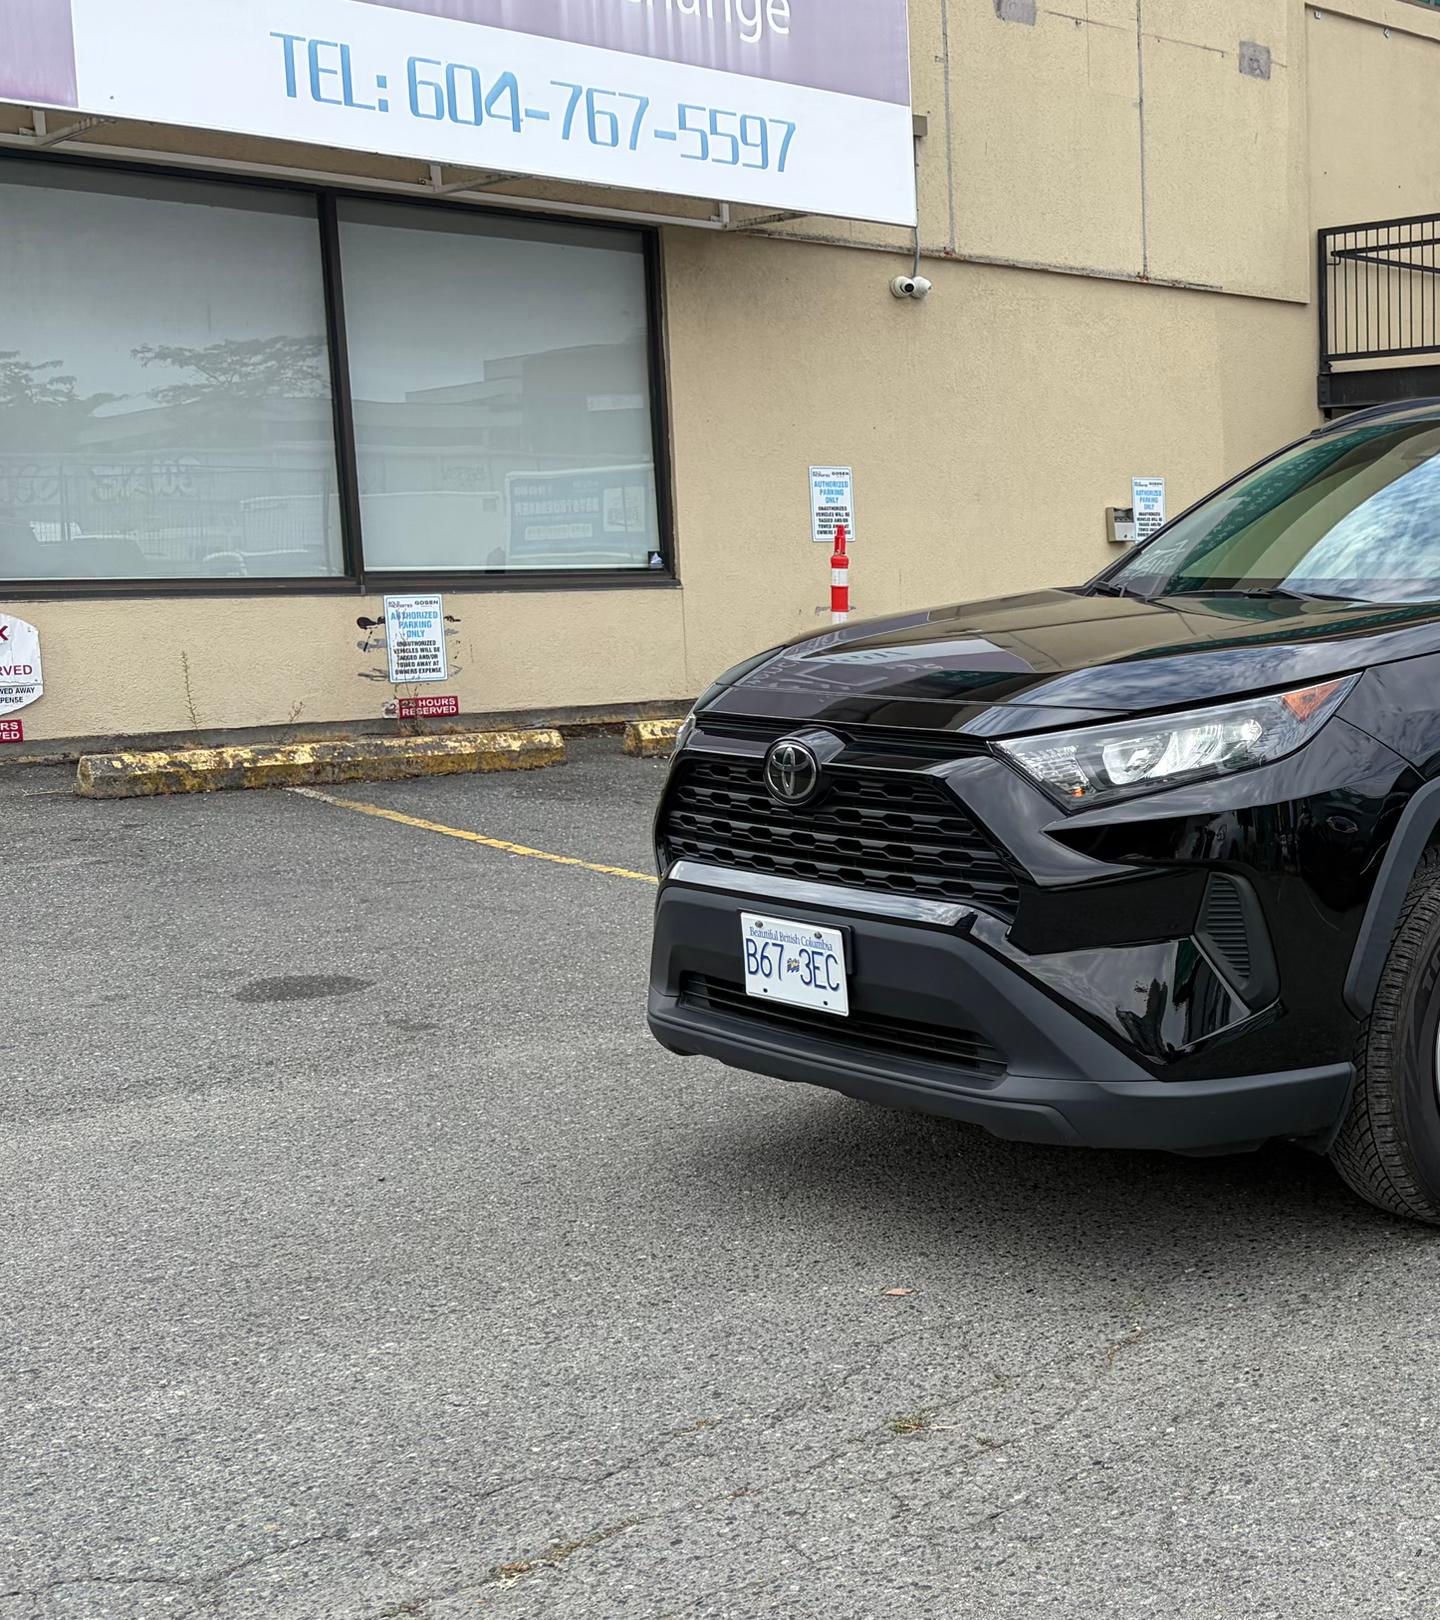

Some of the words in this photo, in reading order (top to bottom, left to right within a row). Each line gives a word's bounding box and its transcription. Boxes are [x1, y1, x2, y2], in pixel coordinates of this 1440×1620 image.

[269, 32, 389, 113] TEL:
[407, 56, 796, 173] 604-767-5597
[391, 611, 438, 620] AUTHORIZED
[398, 621, 432, 629] PARKING
[407, 630, 425, 638] ONLY
[418, 698, 456, 707] HOURS
[402, 706, 457, 716] RESERVED
[749, 926, 778, 940] Beautiful
[780, 931, 800, 945] British
[801, 936, 833, 951] Columbia
[746, 938, 784, 981] B67
[799, 948, 840, 991] 3EC
